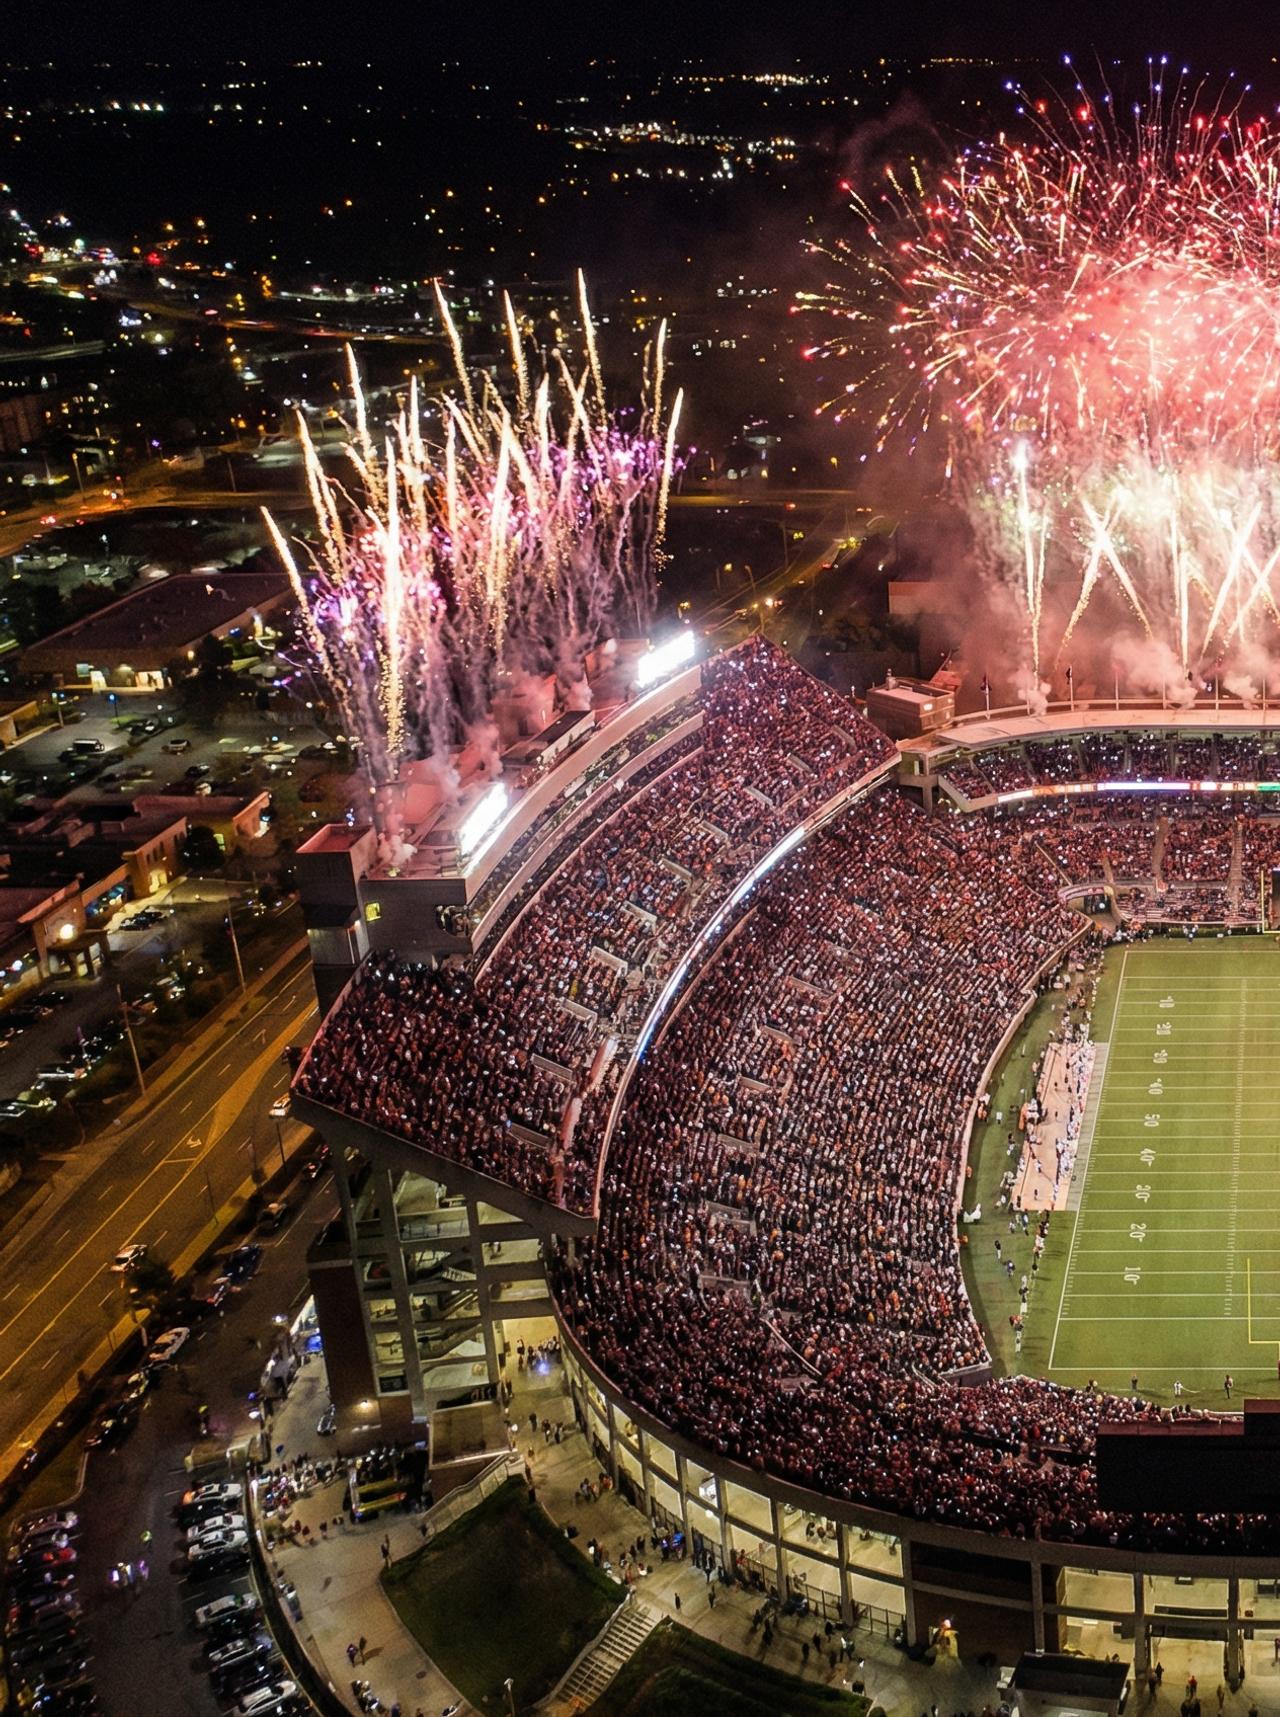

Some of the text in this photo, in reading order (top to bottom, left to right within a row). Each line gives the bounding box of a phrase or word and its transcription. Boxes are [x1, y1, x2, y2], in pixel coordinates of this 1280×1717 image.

[1144, 1113, 1160, 1127] 50
[1140, 1148, 1156, 1161] 40
[1135, 1184, 1151, 1199] 30
[1129, 1223, 1147, 1238] 20
[1124, 1267, 1142, 1281] 10
